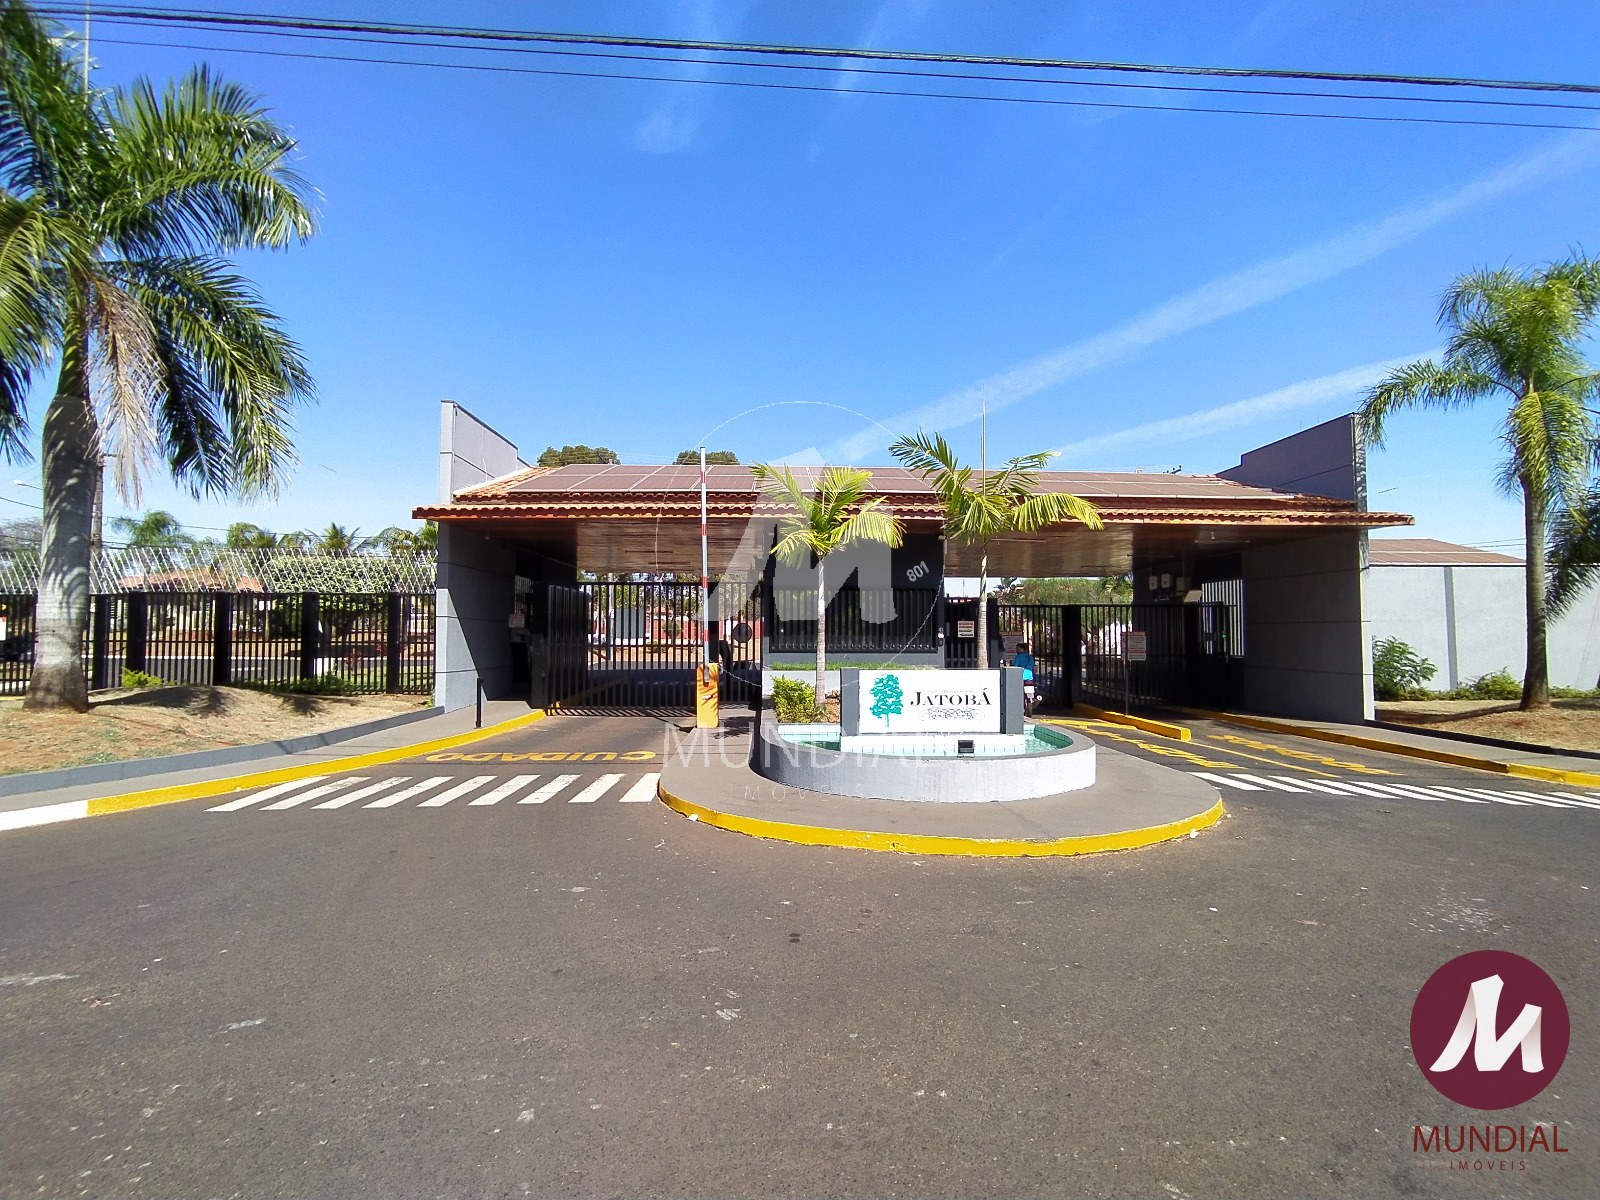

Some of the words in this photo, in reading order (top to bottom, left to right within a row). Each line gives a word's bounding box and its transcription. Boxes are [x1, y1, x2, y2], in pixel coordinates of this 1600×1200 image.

[906, 560, 930, 582] 801
[910, 688, 992, 706] JATOBÁ
[426, 750, 656, 762] CUIDADO
